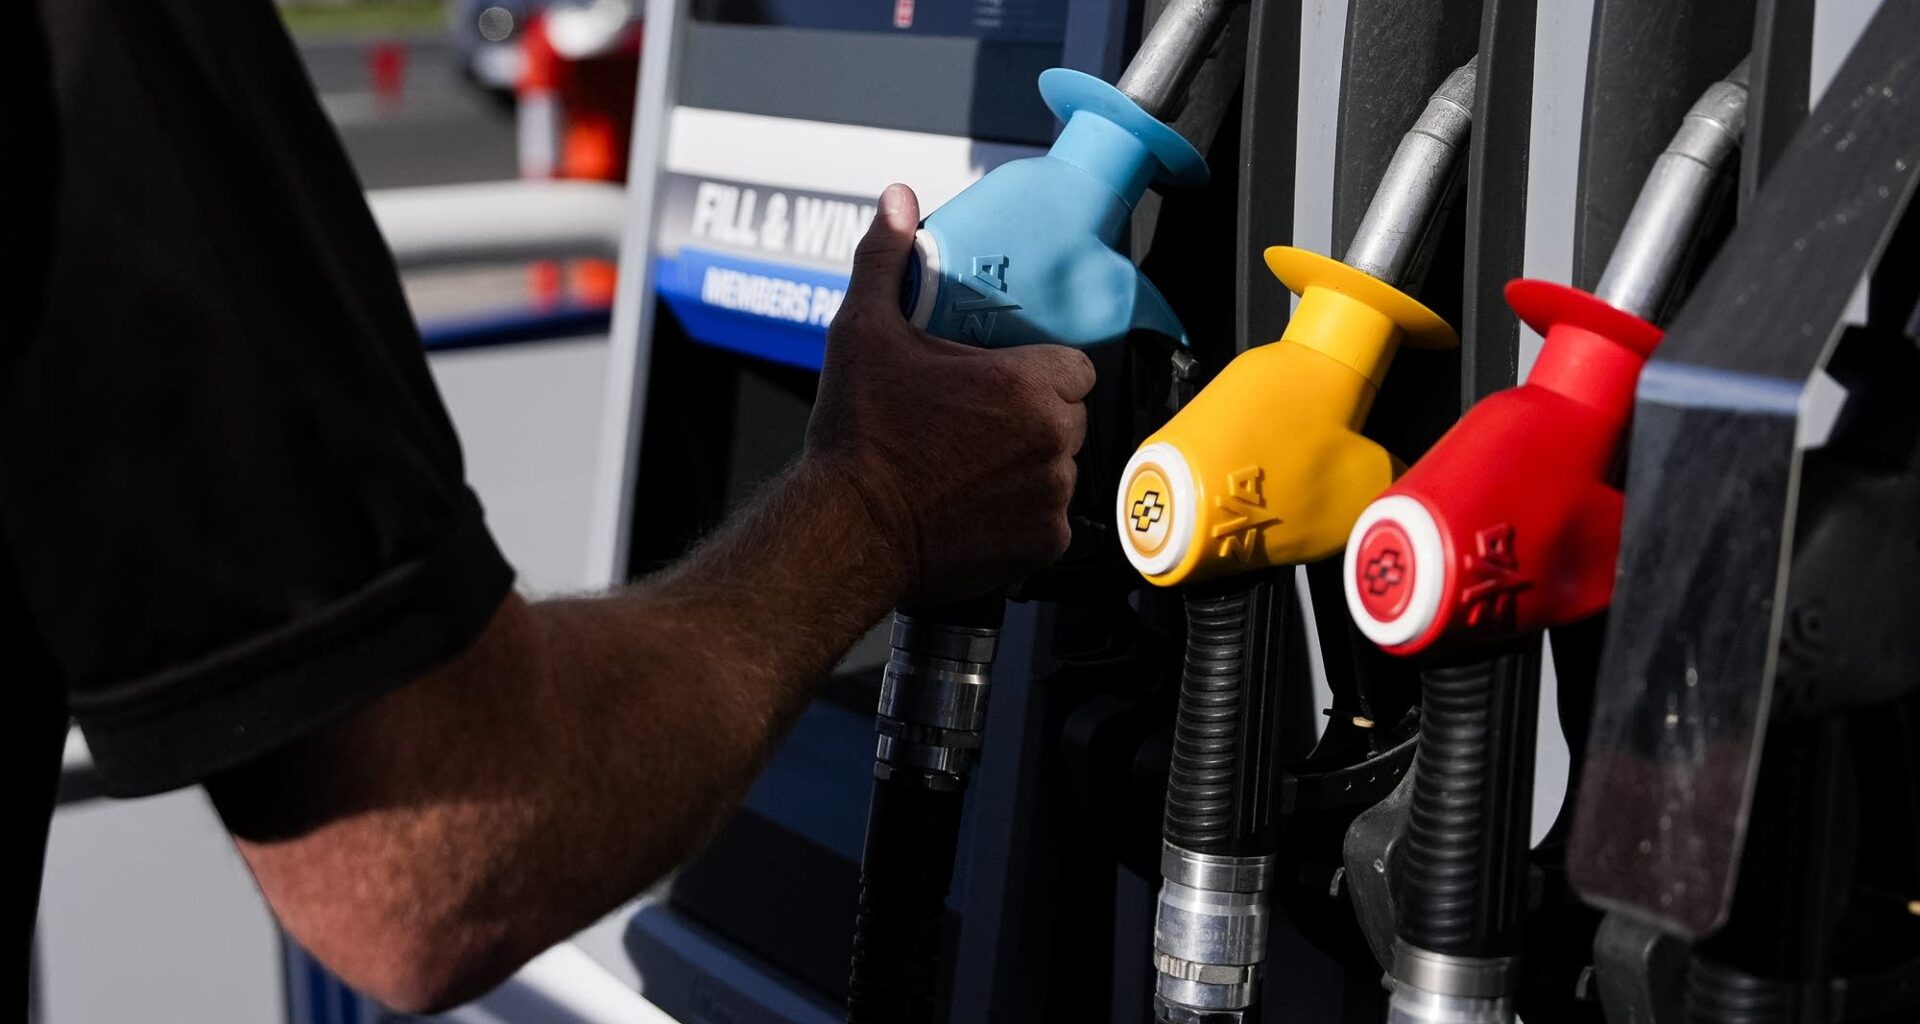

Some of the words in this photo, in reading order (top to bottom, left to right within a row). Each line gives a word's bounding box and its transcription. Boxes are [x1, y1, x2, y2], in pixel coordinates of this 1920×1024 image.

[692, 181, 758, 246] FILL
[761, 192, 789, 251] &
[793, 196, 877, 259] WIN
[702, 266, 812, 322] MEMBERS
[952, 254, 1023, 347] ZVA
[1211, 465, 1281, 563] ZVA
[1461, 522, 1534, 628] ZVA
